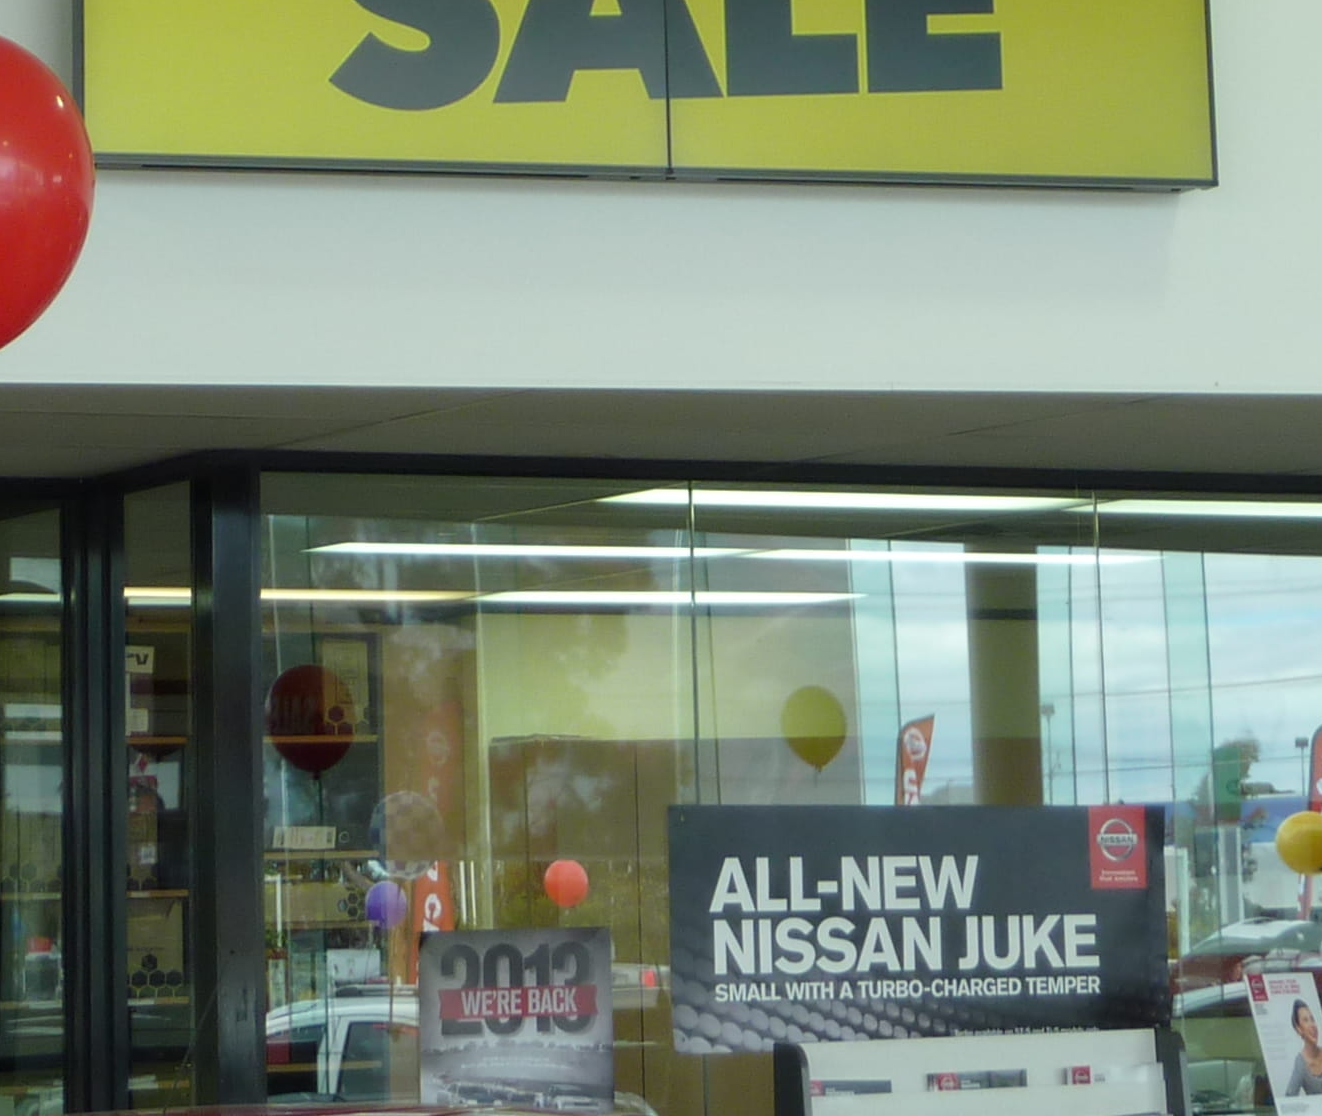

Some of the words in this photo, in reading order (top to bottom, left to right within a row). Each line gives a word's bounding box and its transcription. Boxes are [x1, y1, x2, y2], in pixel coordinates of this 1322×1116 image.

[708, 855, 979, 913] ALL-NEW
[713, 916, 942, 975] NISSAN
[958, 914, 1101, 970] JUKE
[440, 941, 592, 1037] 2013
[460, 989, 523, 1017] WE'RE
[527, 986, 578, 1015] BACK
[714, 983, 781, 1003] SMALL
[786, 981, 835, 1000] WITH
[839, 980, 854, 1000] A
[857, 977, 1022, 999] TURBO-CHARGED
[1025, 975, 1102, 996] TEMPER
